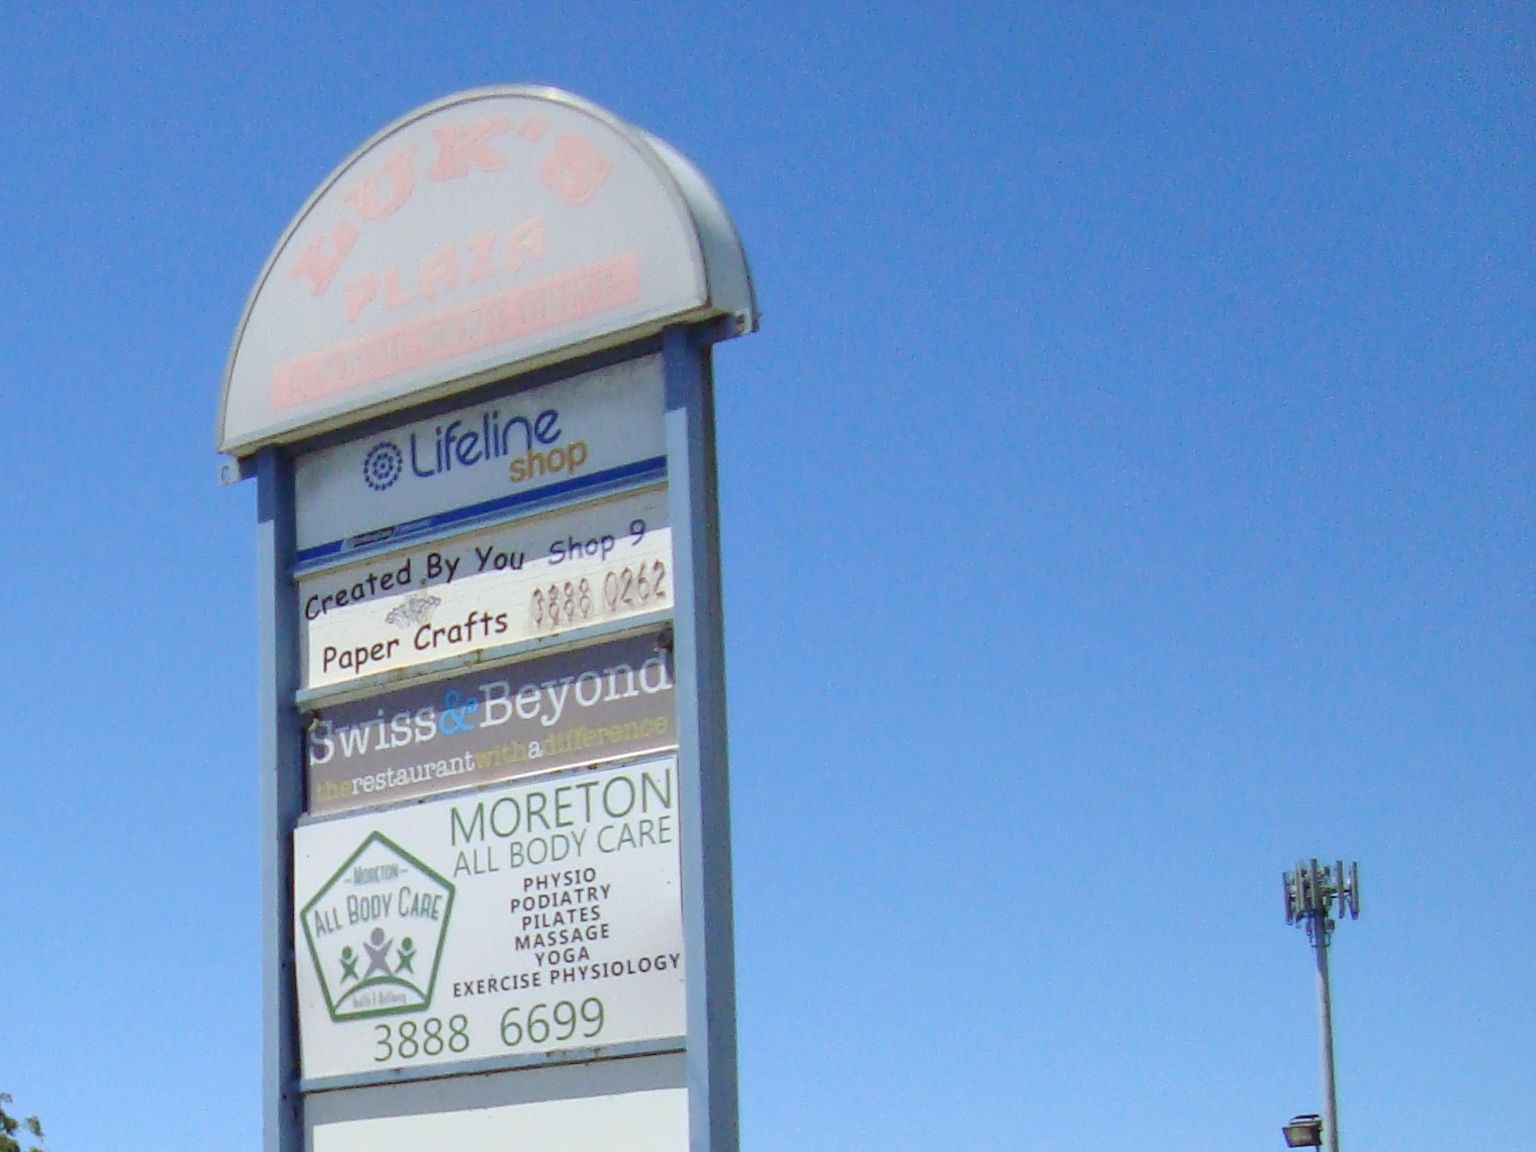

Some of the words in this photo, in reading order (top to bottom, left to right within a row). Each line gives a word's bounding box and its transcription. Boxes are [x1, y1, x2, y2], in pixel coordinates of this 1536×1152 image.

[345, 215, 547, 323] PLAZA
[410, 408, 562, 479] Lifeline
[509, 439, 588, 483] shop
[305, 559, 412, 620] Created
[427, 552, 460, 584] By
[475, 545, 524, 572] You
[548, 530, 615, 565] Shop
[629, 519, 647, 547] 9
[532, 577, 591, 628] 3888
[604, 559, 666, 612] 0262
[322, 639, 400, 674] Paper
[414, 610, 509, 651] Crafts
[478, 655, 674, 728] Beyond
[450, 768, 672, 847] MORETON
[453, 846, 499, 878] ALL
[510, 828, 586, 869] BODY
[597, 815, 672, 854] CARE
[510, 884, 611, 913] PODIATRY
[523, 868, 596, 892] PHYSIO
[314, 907, 342, 938] ALL
[348, 893, 392, 926] BODY
[398, 886, 442, 921] CARE
[514, 923, 610, 951] MASSAGE
[522, 905, 600, 931] PILATES
[453, 972, 541, 998] EXERCISE
[550, 953, 680, 984] PHYSIOLOGY
[535, 946, 590, 967] YOGA
[374, 1014, 470, 1062] 3888
[500, 997, 605, 1047] 6699
